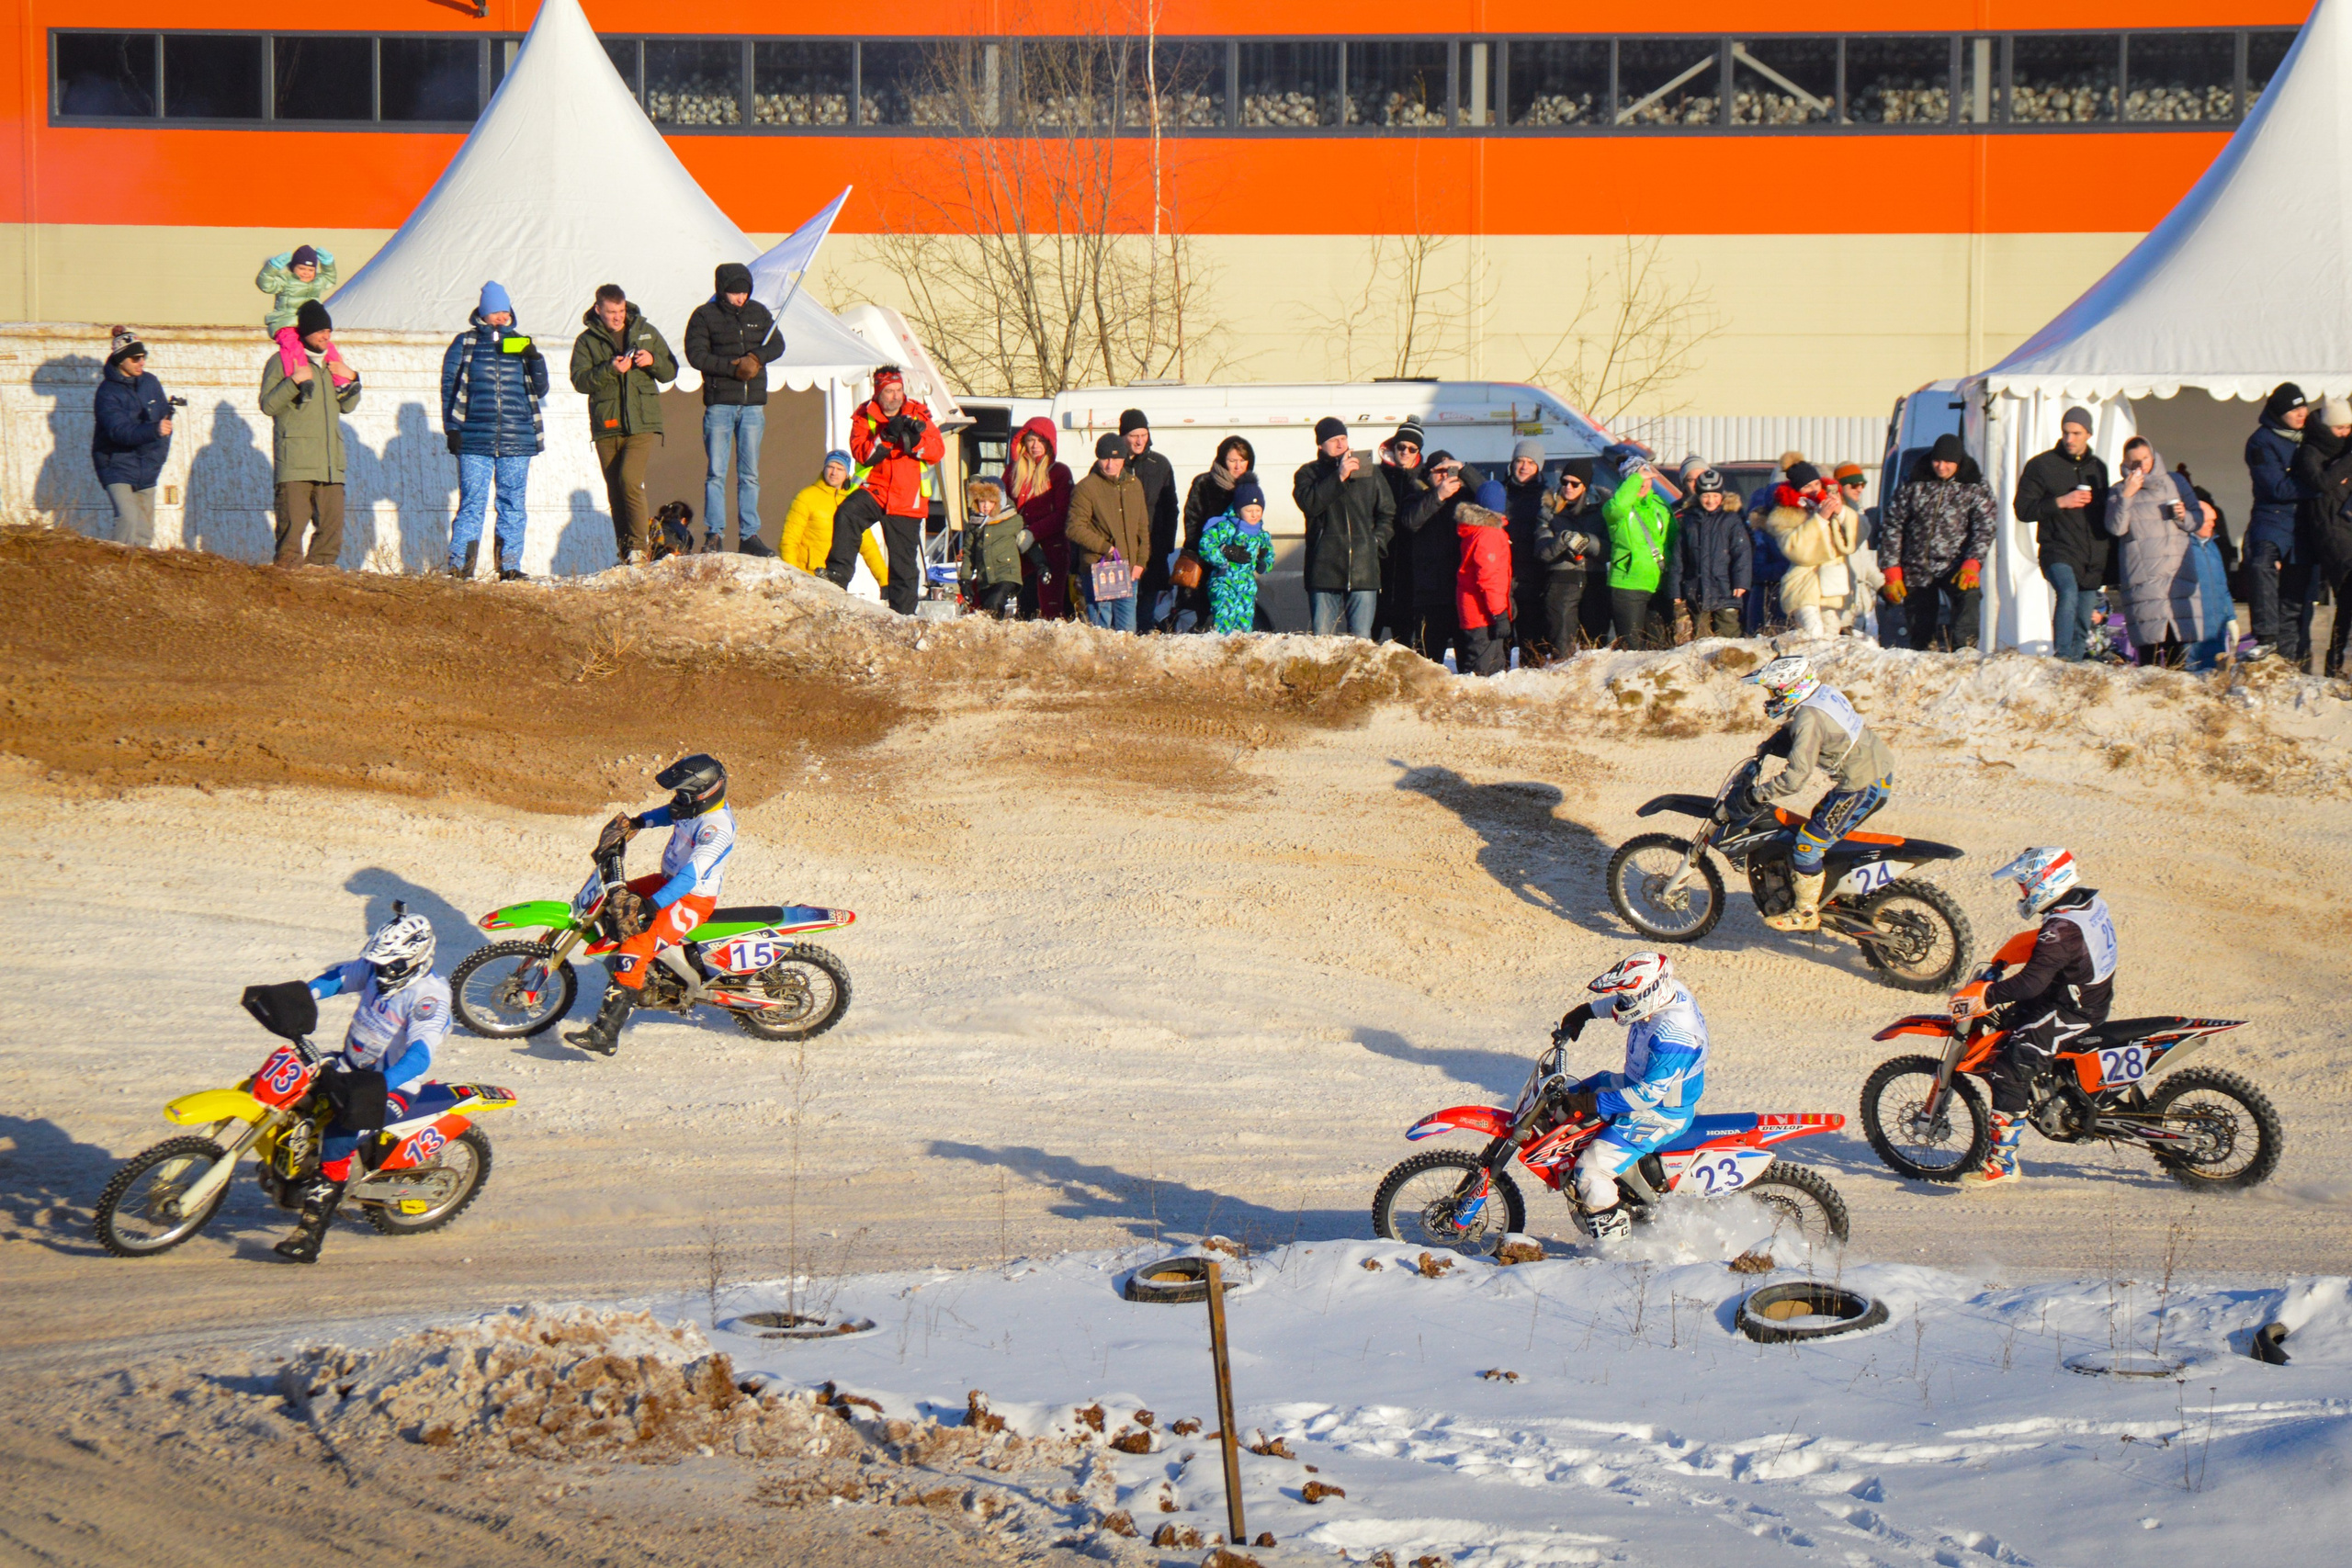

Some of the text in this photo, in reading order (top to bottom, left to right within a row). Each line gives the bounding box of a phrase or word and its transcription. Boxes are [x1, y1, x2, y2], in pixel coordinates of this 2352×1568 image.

[1855, 862, 1894, 894] 24
[732, 942, 774, 969] 15
[1637, 972, 1669, 1001] 100%
[1952, 1002, 1970, 1015] 47
[262, 1053, 302, 1094] 13
[2102, 1047, 2143, 1081] 28
[403, 1126, 447, 1167] 13
[1695, 1157, 1745, 1197] 23
[1457, 1182, 1486, 1220] DUNLOP
